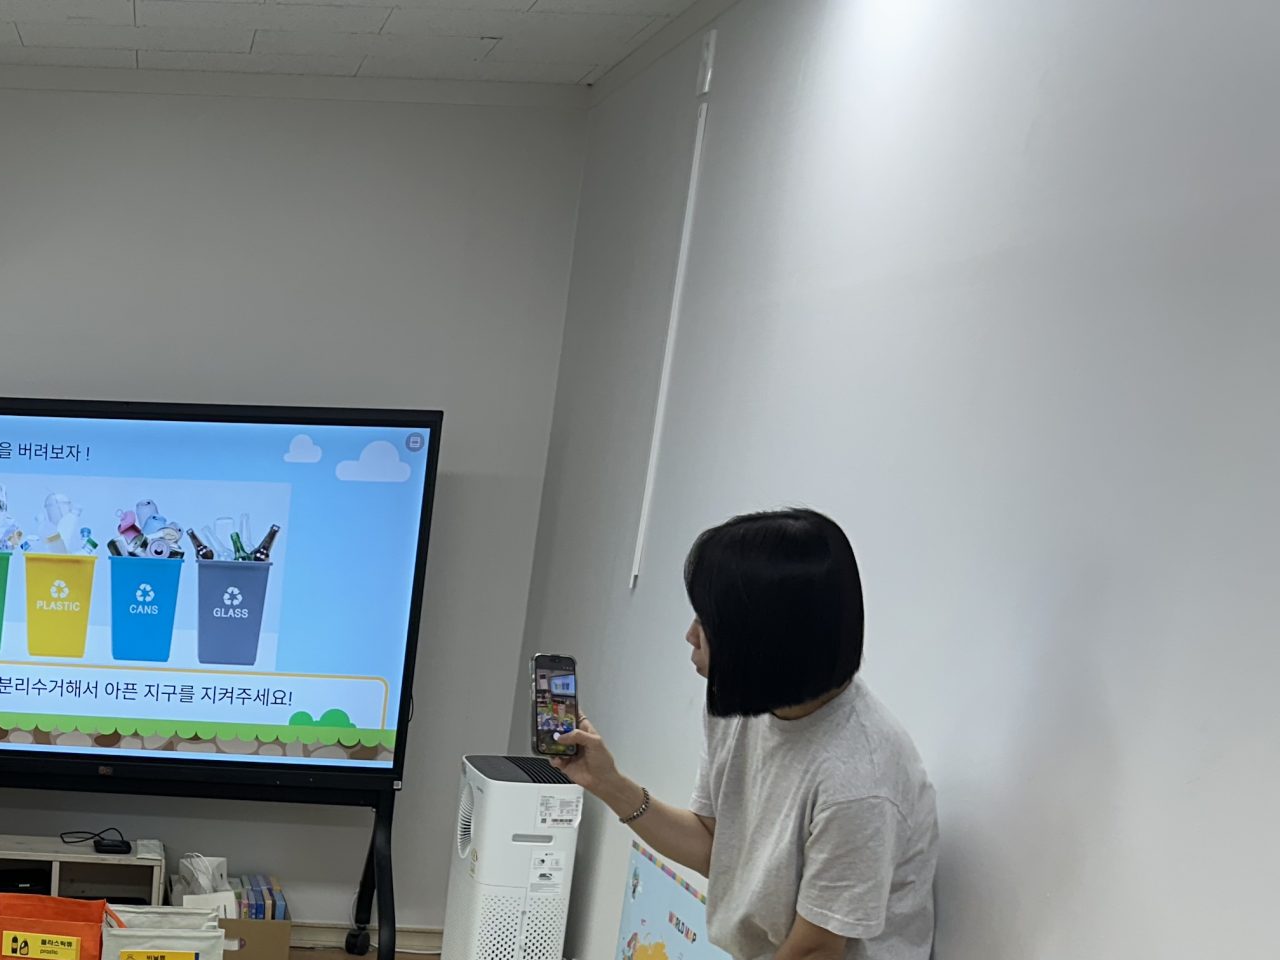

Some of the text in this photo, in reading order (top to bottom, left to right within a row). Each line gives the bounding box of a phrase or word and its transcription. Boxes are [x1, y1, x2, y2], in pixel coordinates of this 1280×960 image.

[19, 442, 81, 462] 버려보자
[36, 600, 81, 612] PLASTIC
[129, 604, 159, 615] CANS
[213, 607, 249, 618] GLASS
[104, 681, 138, 700] 아픈
[144, 683, 195, 702] 지구를
[200, 685, 293, 707] 지켜주세요!
